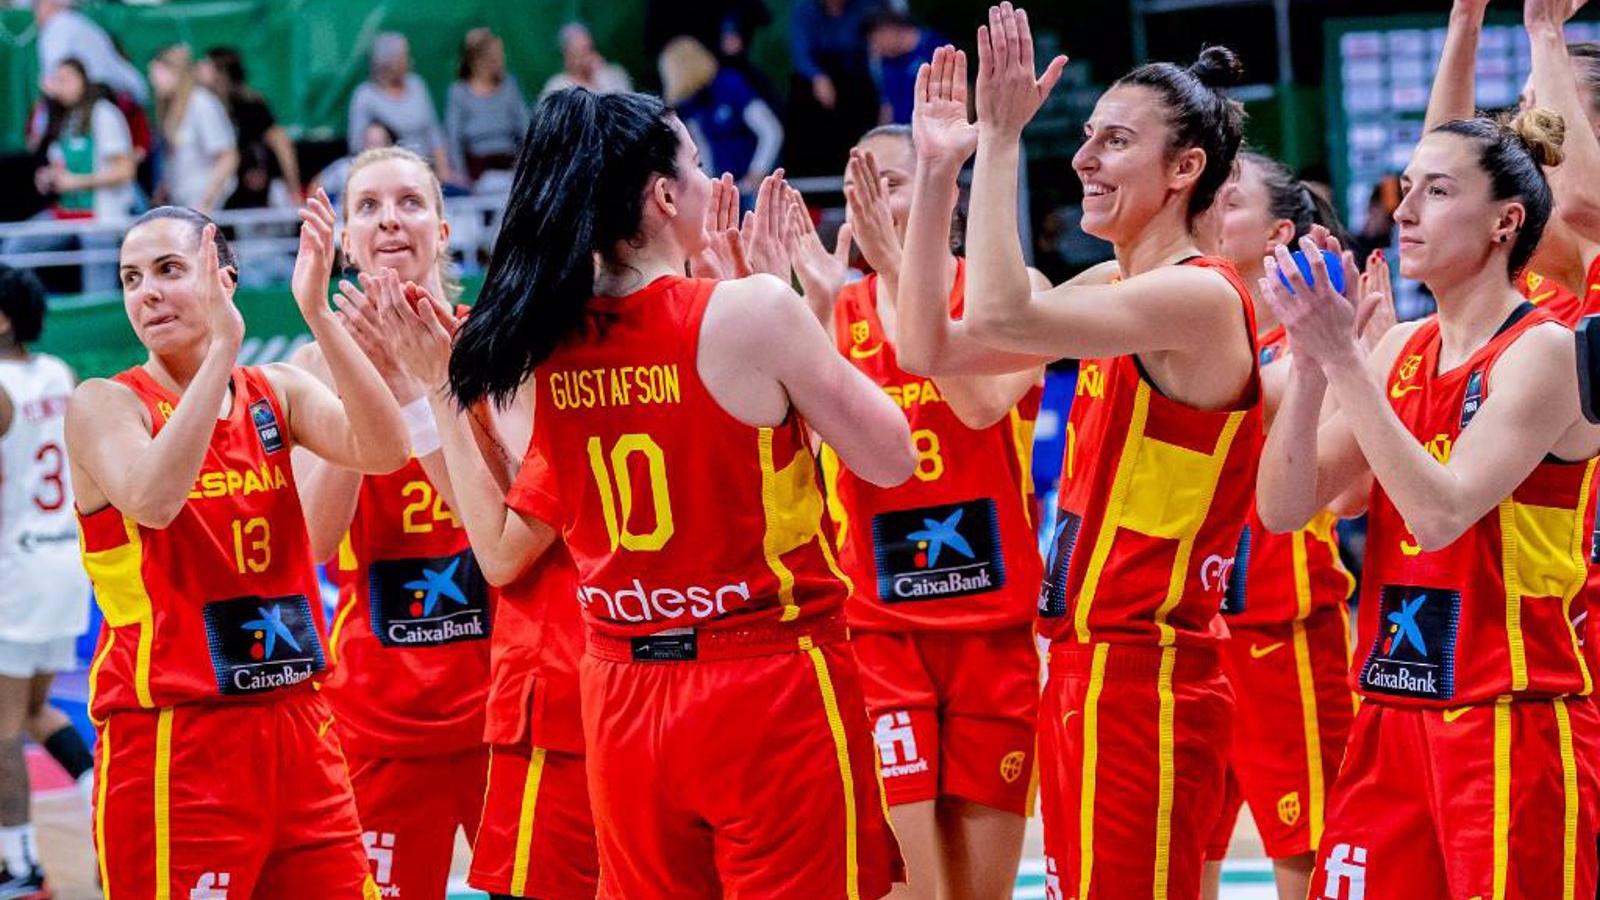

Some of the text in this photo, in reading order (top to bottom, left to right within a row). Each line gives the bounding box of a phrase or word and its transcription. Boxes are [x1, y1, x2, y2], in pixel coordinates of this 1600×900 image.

[550, 364, 681, 409] GUSTAFSON
[882, 380, 942, 409] SPA
[34, 443, 65, 512] 3
[911, 429, 944, 482] 8
[402, 480, 464, 533] 24
[587, 433, 674, 553] 10
[232, 516, 273, 574] 13
[577, 579, 750, 622] ndesa
[893, 567, 992, 598] CaixaBank
[388, 615, 484, 643] CaixaBank
[1366, 663, 1438, 694] CaixaBank
